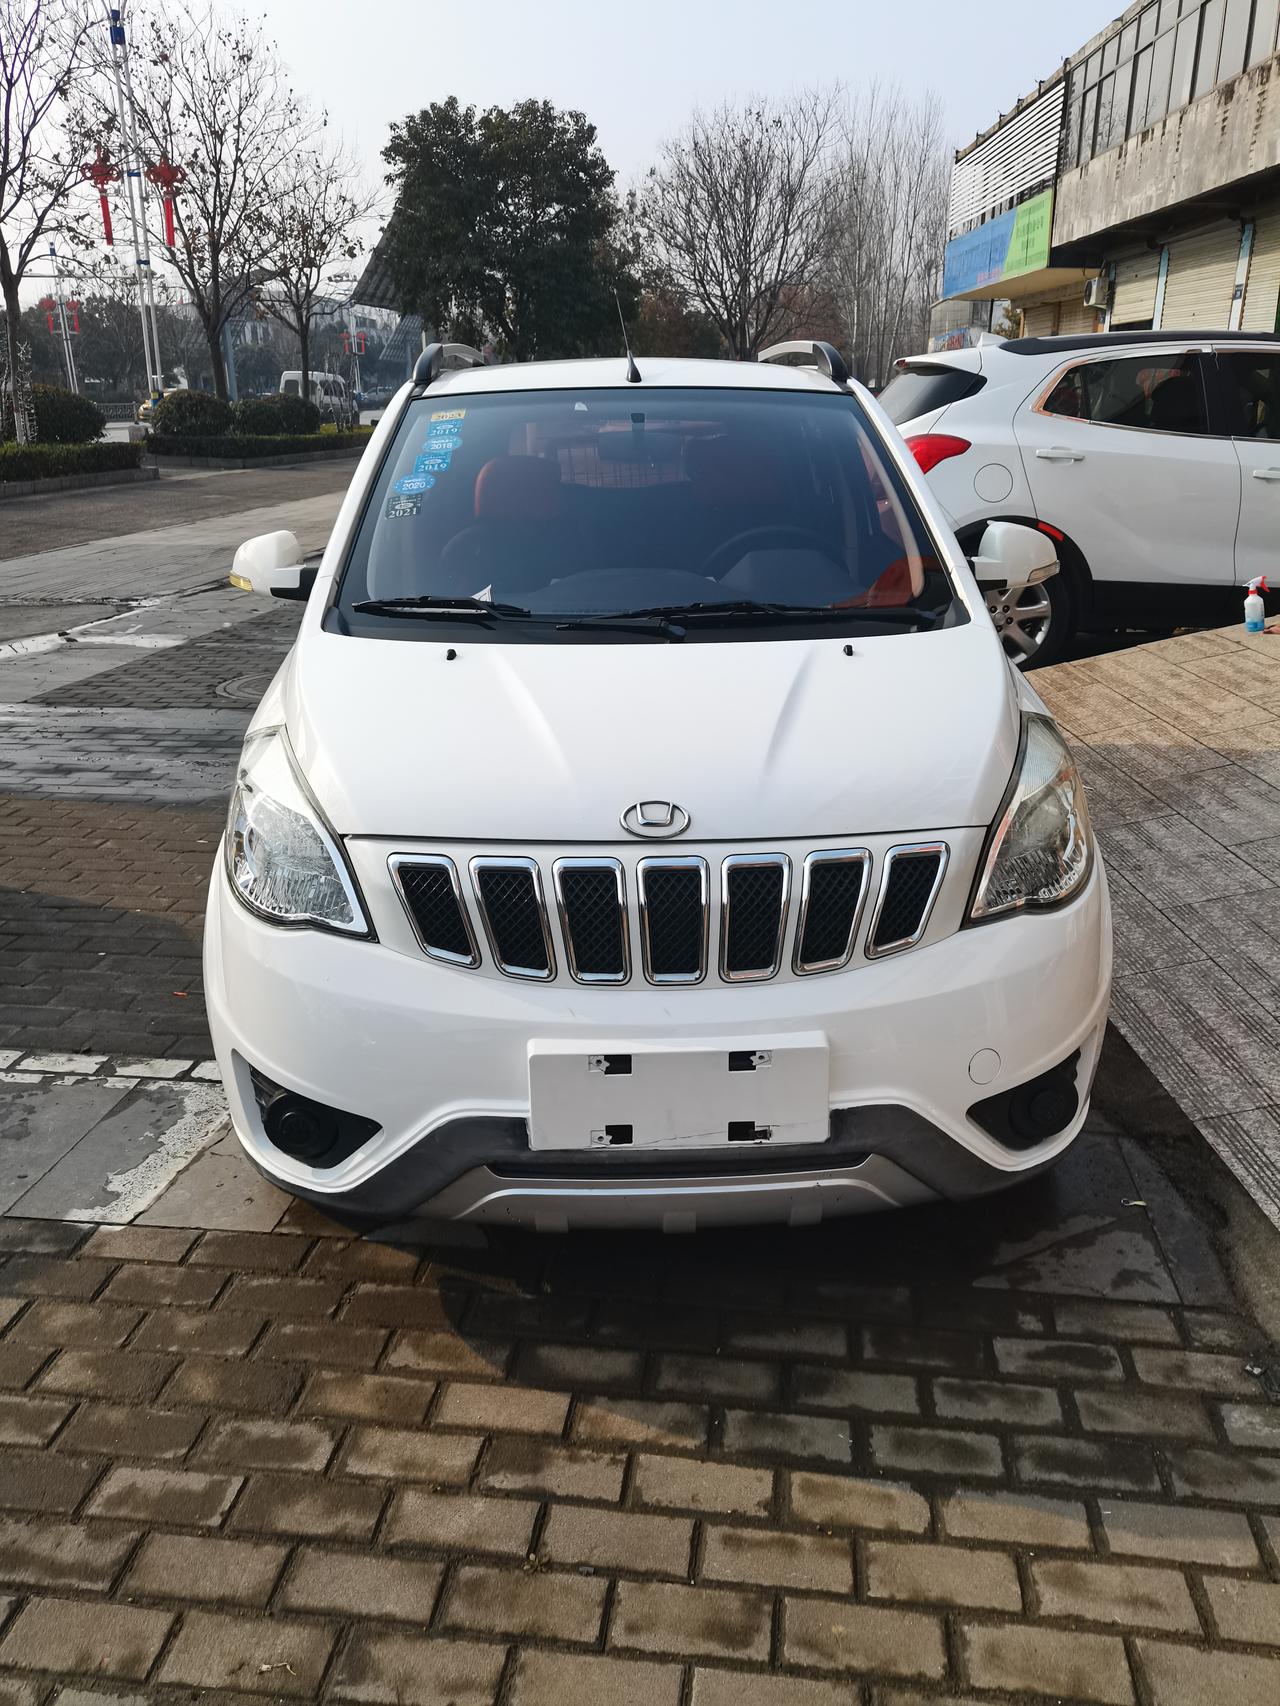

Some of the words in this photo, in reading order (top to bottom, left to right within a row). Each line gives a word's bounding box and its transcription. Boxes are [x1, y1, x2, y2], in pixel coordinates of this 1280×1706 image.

[417, 463, 447, 472] 2019
[402, 481, 426, 491] 2020
[388, 507, 417, 519] 2021
